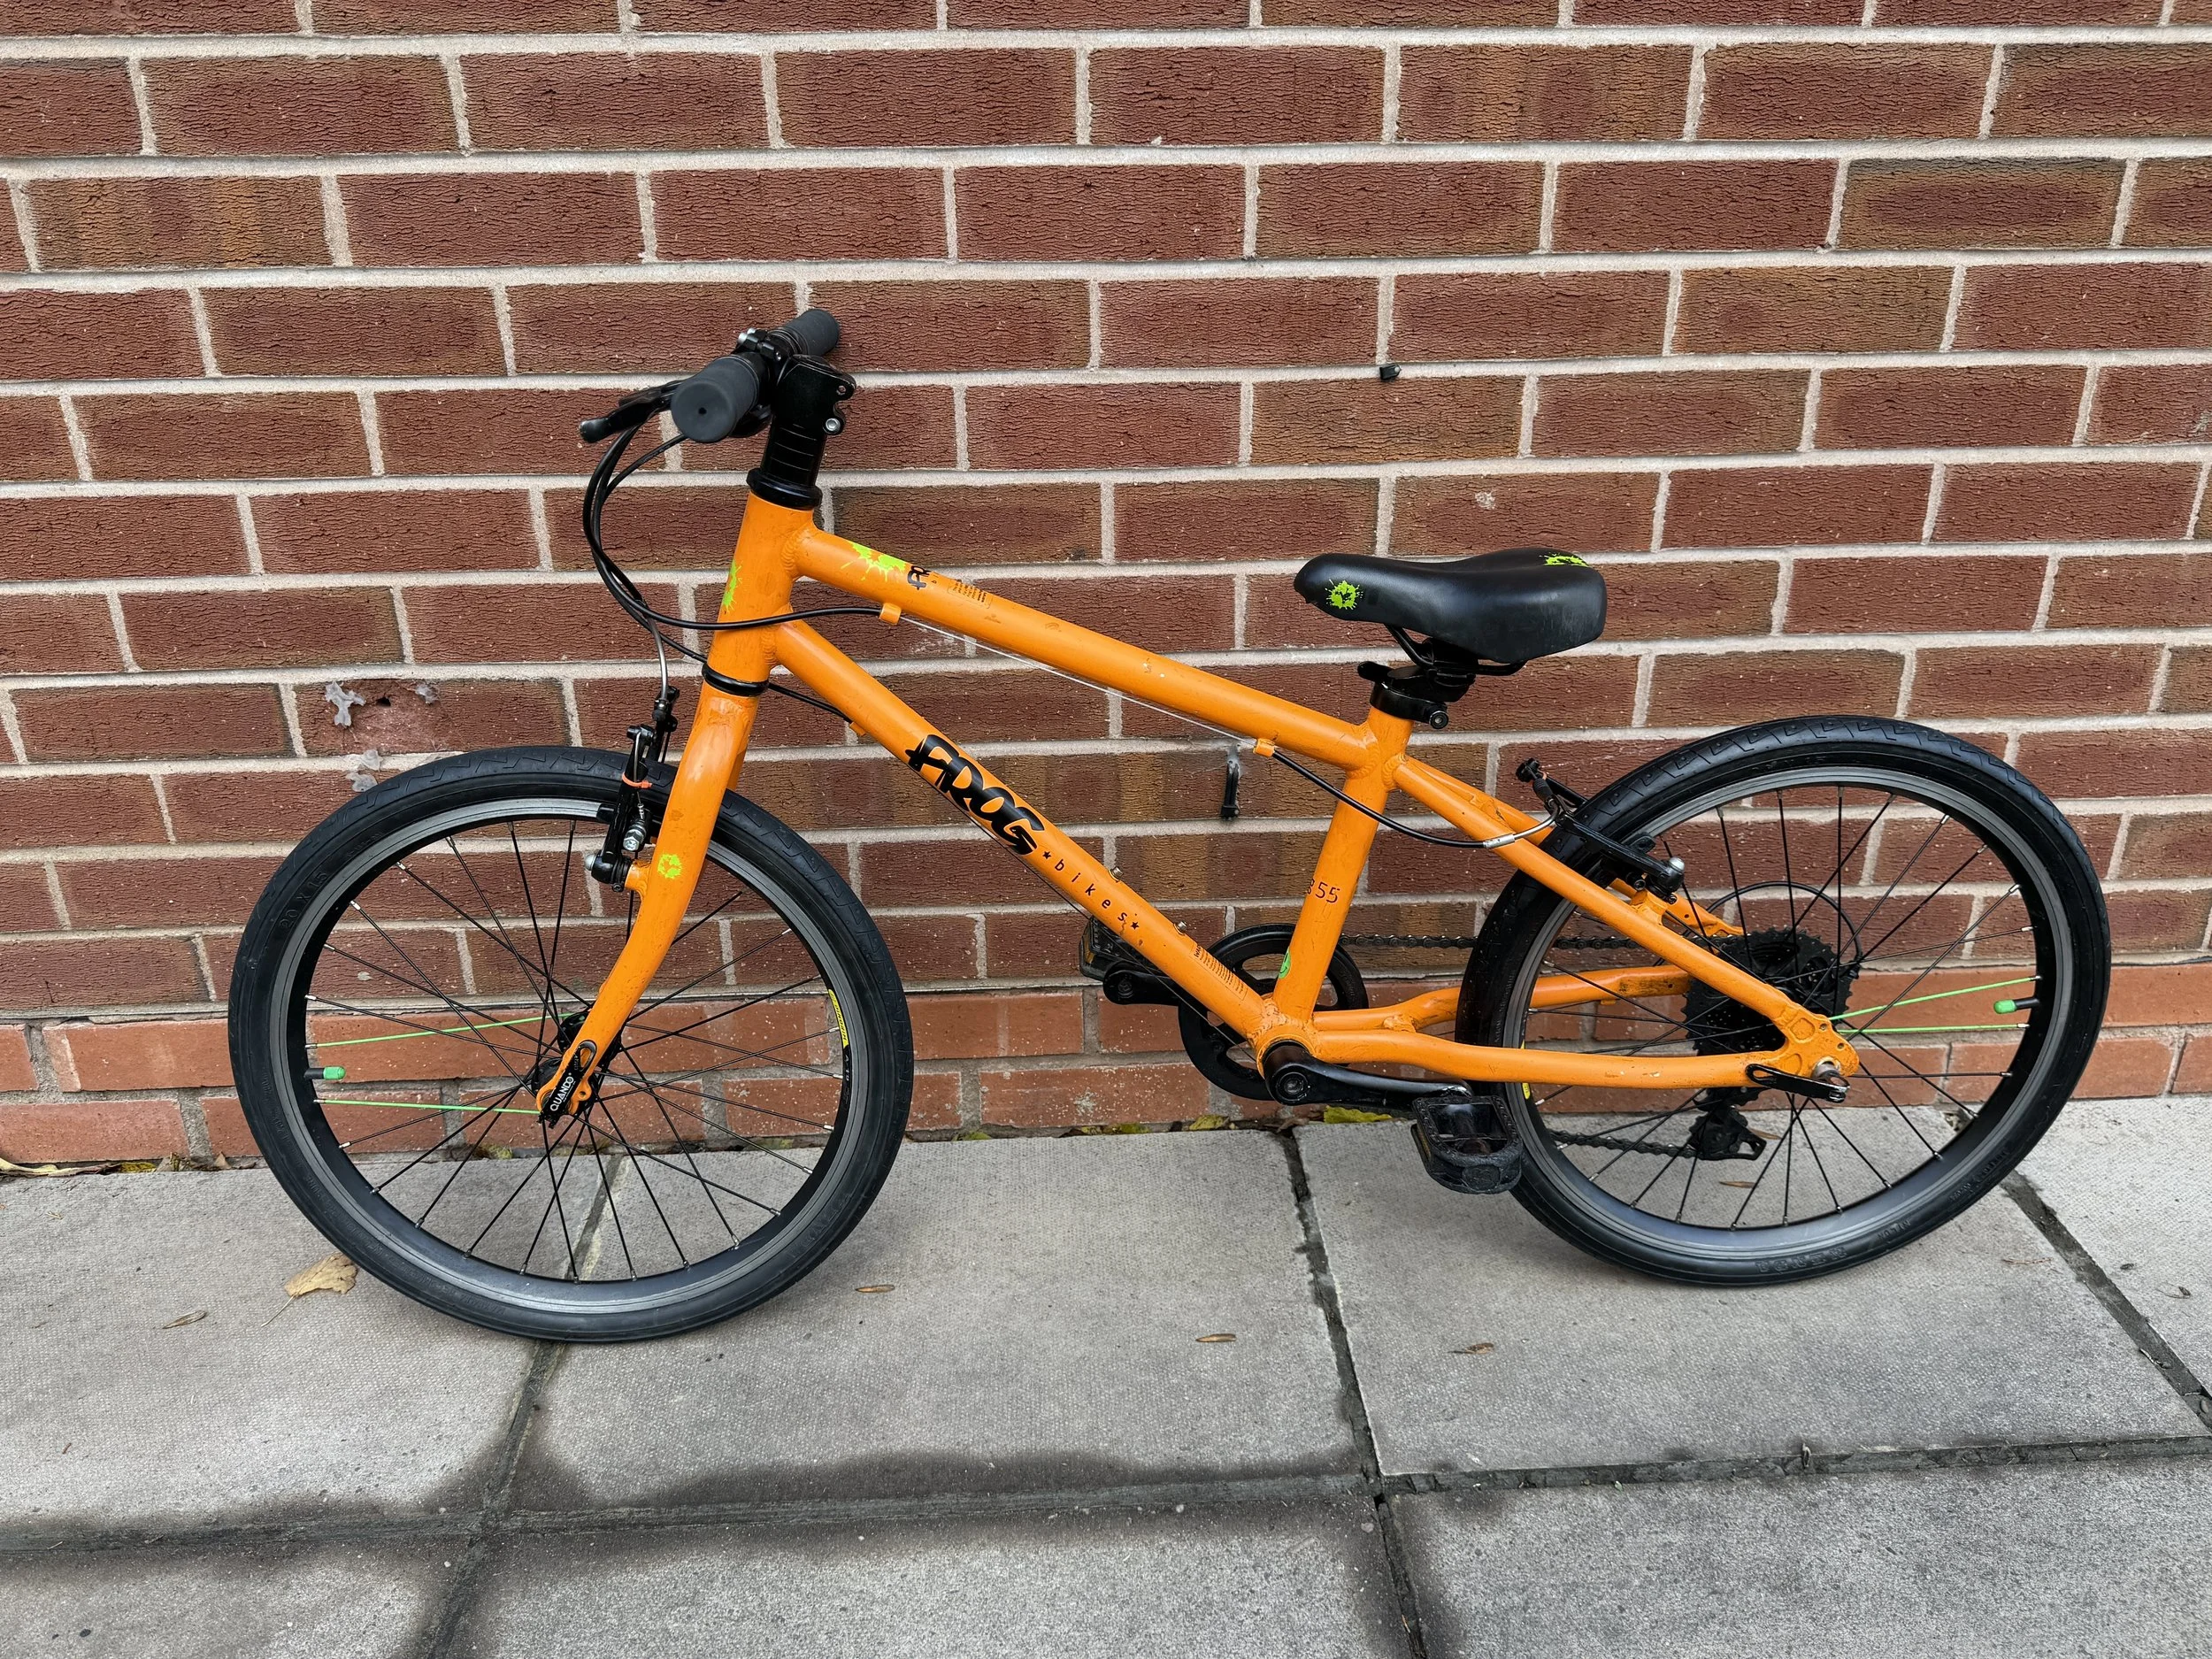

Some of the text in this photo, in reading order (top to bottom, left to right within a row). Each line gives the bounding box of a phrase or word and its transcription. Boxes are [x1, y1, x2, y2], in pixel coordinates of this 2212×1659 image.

[904, 733, 1128, 922] FROG bikes
[549, 1076, 574, 1111] QUANDO
